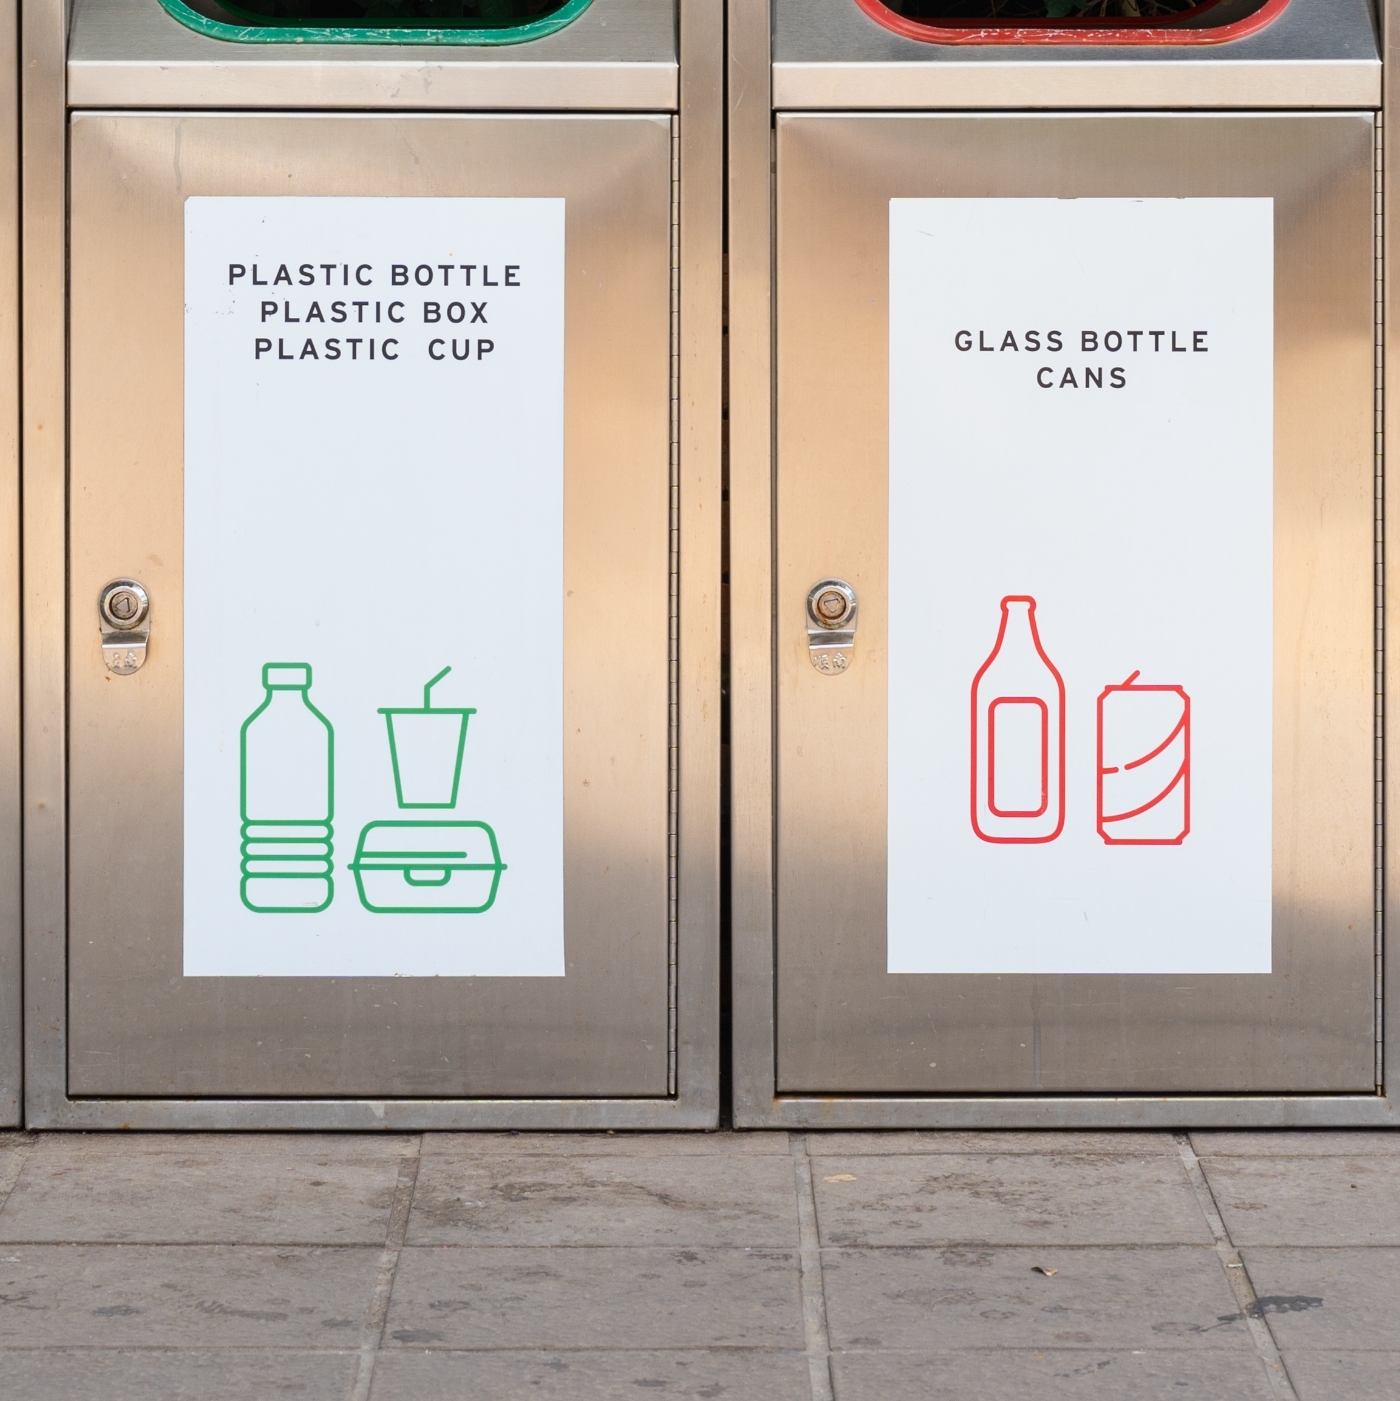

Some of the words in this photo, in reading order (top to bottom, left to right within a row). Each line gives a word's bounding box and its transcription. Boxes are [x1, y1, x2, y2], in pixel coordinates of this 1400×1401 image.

[229, 263, 373, 286] PLASTIC
[391, 264, 521, 287] BOTTLE
[261, 300, 405, 324] PLASTIC
[423, 301, 488, 324] BOX
[255, 338, 399, 361] PLASTIC
[428, 338, 495, 361] CUP
[954, 330, 1063, 352] GLASS
[1081, 330, 1208, 353] BOTTLE
[1036, 366, 1126, 389] CANS
